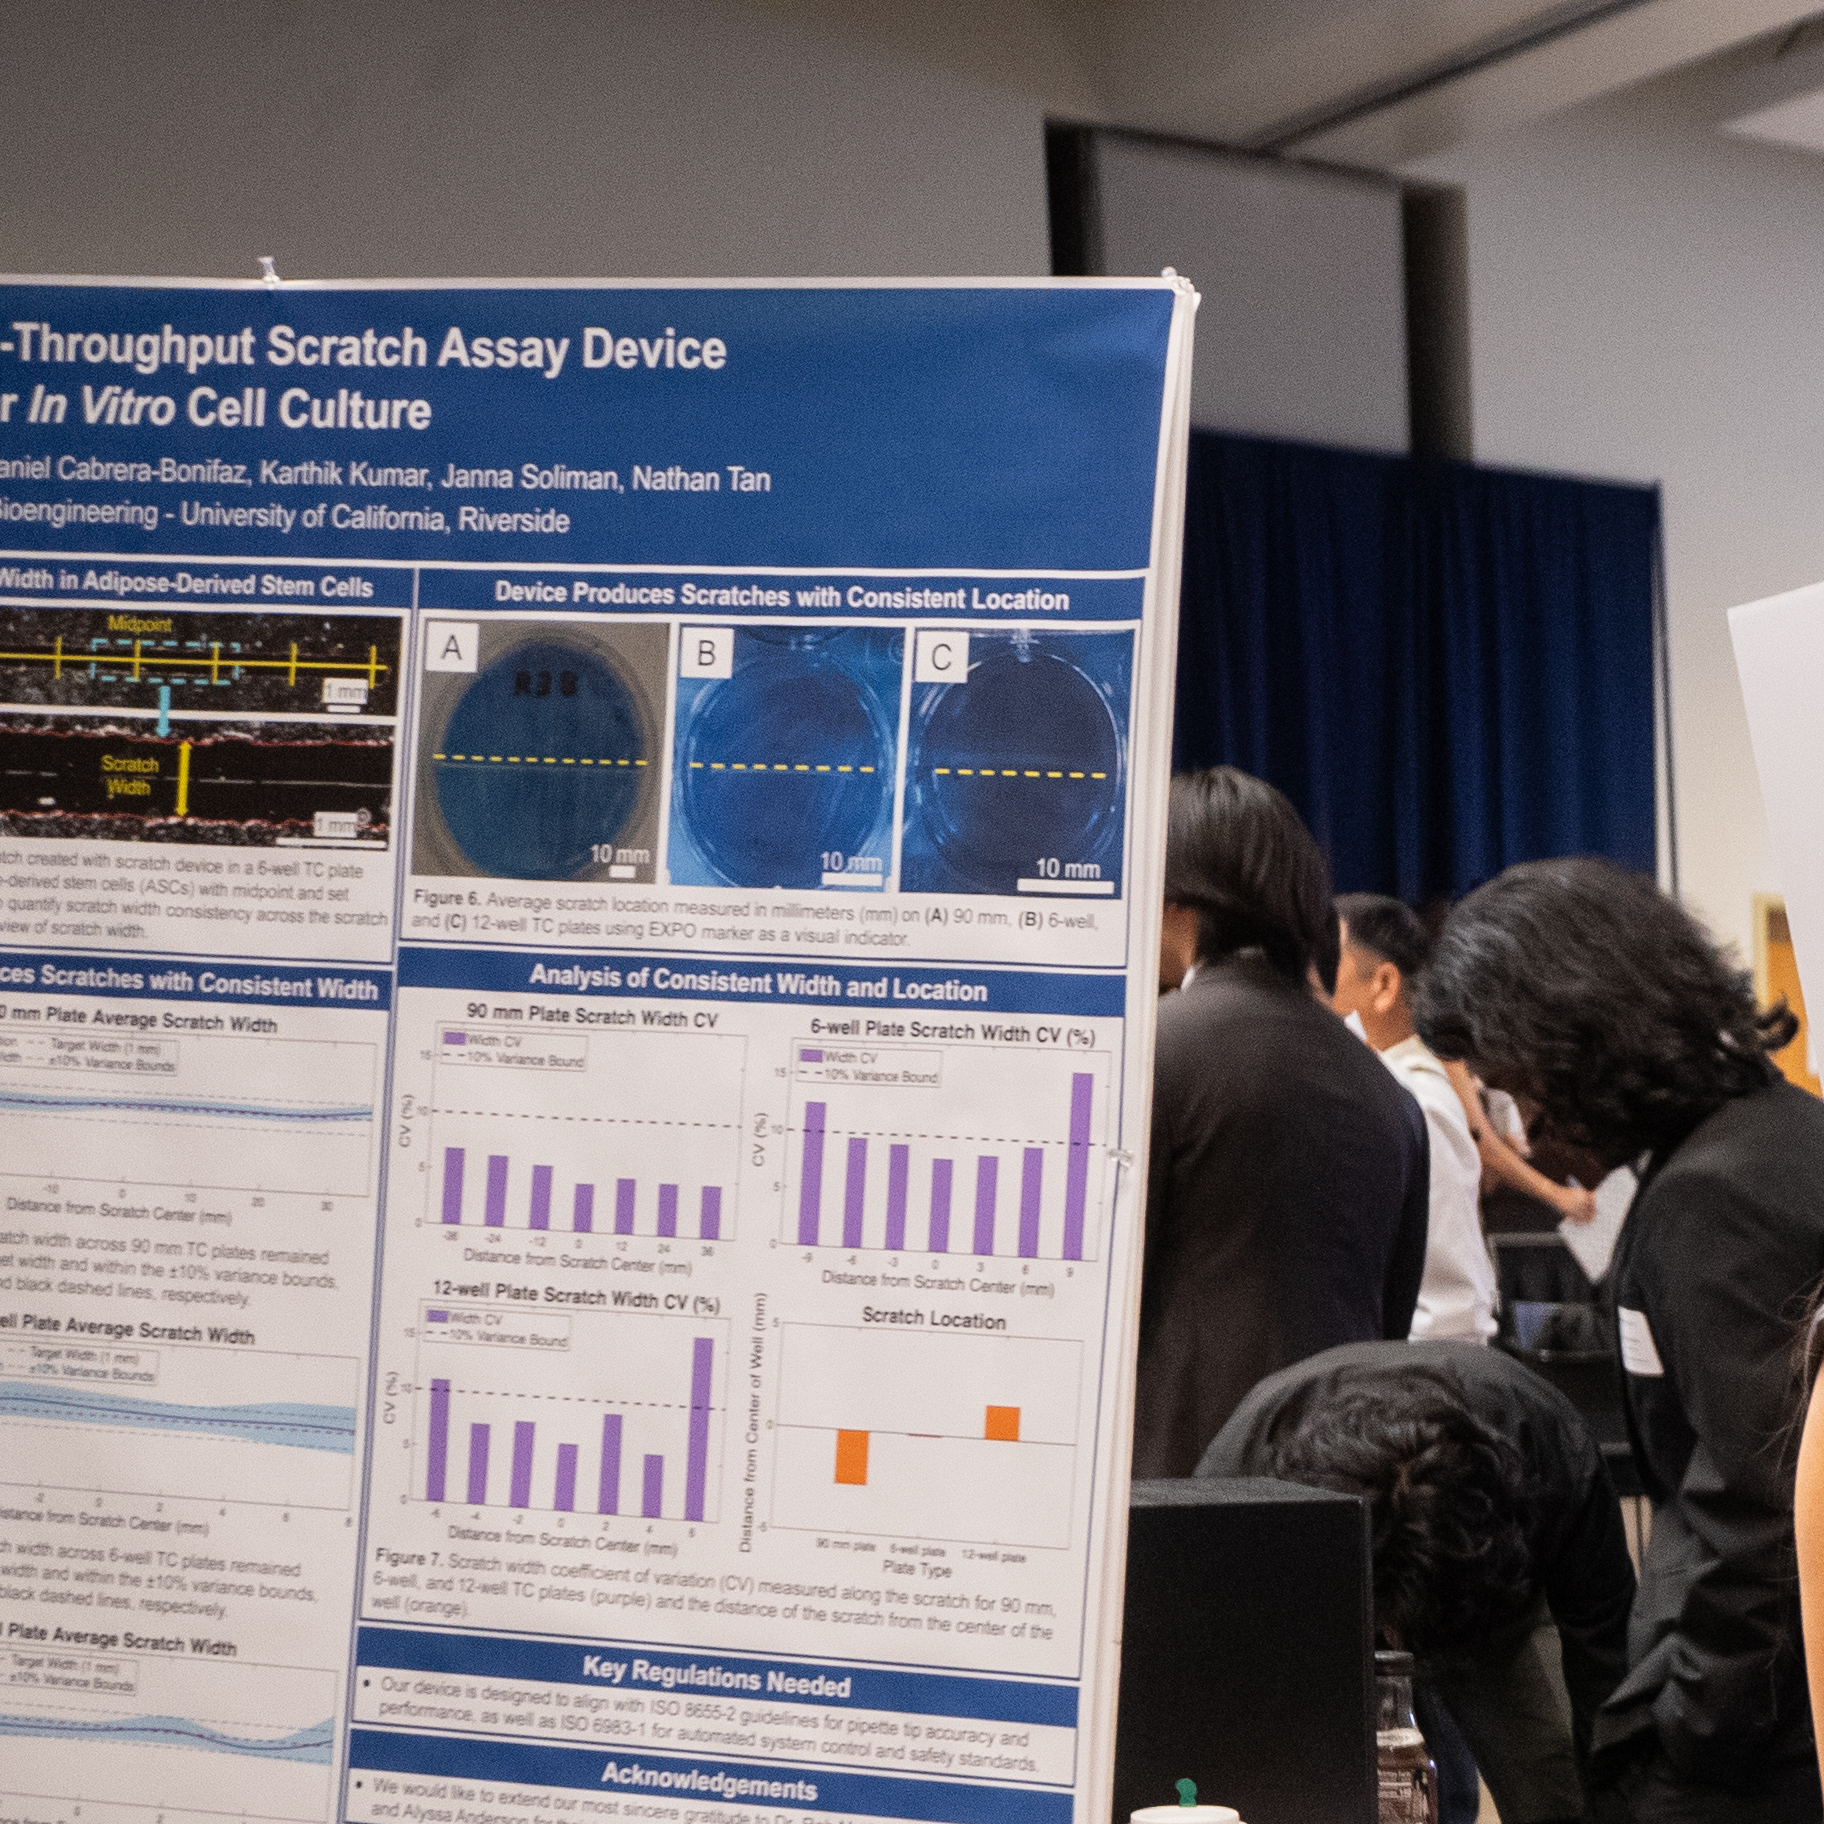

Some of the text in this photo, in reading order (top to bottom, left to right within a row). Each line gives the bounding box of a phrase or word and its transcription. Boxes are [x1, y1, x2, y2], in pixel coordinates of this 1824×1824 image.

[267, 325, 427, 367] Scratch
[436, 326, 570, 380] Assay
[582, 326, 727, 370] Device
[27, 384, 68, 424] In
[81, 385, 176, 426] Vitro
[187, 386, 266, 427] Cell
[278, 387, 432, 430] Culture
[56, 456, 252, 486] Cabrera-Bonifaz,
[259, 458, 343, 484] Karthik
[349, 461, 433, 490] Kumar,
[441, 463, 513, 489] Janna
[520, 463, 624, 494] Soliman,
[632, 465, 720, 491] Nathan
[727, 466, 771, 492] Tan
[0, 496, 158, 530] ioengineering
[180, 501, 296, 534] University
[302, 503, 327, 527] of
[331, 503, 451, 534] California,
[458, 505, 570, 534] Riverside
[0, 568, 374, 598] Width in Adipose-Derived Stem Cells
[495, 580, 1070, 611] Device Produces Scratches with Consistent Location
[108, 615, 172, 633] Midpoint
[441, 634, 462, 661] A
[698, 640, 716, 666] B
[931, 644, 952, 670] C
[101, 755, 159, 772] Scratch
[107, 779, 151, 796] Width
[590, 844, 650, 862] 10 mm
[821, 852, 883, 871] 10 mm
[1037, 859, 1101, 878] 10 mm
[413, 889, 462, 908] Figure
[488, 892, 552, 912] Average
[556, 896, 608, 912] scratch
[612, 896, 668, 914] location
[674, 900, 749, 918] measured
[755, 902, 766, 917] in
[771, 903, 854, 922] millimeters
[859, 907, 898, 925] (mm)
[902, 911, 920, 924] on
[925, 907, 948, 926] (A)
[954, 909, 973, 924] 90
[1019, 911, 1043, 929] (B)
[412, 915, 441, 929] and
[445, 912, 467, 932] (C)
[473, 915, 527, 932] 12-well
[532, 917, 554, 933] TC
[558, 919, 601, 937] plates
[606, 922, 643, 940] using
[649, 922, 695, 938] EXPO
[702, 924, 753, 940] marker
[758, 928, 775, 941] as
[780, 930, 789, 942] a
[794, 927, 839, 944] visual
[40, 963, 144, 990] Scratches
[149, 970, 193, 992] with
[199, 971, 312, 997] Consistent
[317, 977, 379, 1001] Width
[529, 963, 988, 1002] Analysis of Consistent Width and Location
[12, 1005, 278, 1034] mm Plate Average Scratch Width
[467, 1002, 719, 1028] 90 mm Plate Scratch Width CV
[811, 1018, 1095, 1048] 6-well Plate Scratch Width CV (%)
[433, 1280, 720, 1315] 12-well Plate Scratch Width CV (%)
[22, 1314, 255, 1345] Plate Average Scratch Width
[862, 1306, 1006, 1330] Scratch Location
[883, 1559, 952, 1579] Plate Type
[8, 1622, 237, 1656] Plate Average Scratch Width
[582, 1655, 851, 1698] Key Regulations Needed
[381, 1676, 409, 1693] Our
[413, 1678, 461, 1698] device
[465, 1683, 477, 1699] is
[482, 1684, 550, 1707] designed
[556, 1691, 569, 1708] to
[574, 1692, 610, 1713] align
[614, 1696, 644, 1713] with
[650, 1699, 678, 1717] ISO
[740, 1709, 818, 1730] guidelines
[824, 1713, 842, 1730] for
[847, 1717, 898, 1739] pipette
[904, 1721, 920, 1740] tip
[926, 1725, 994, 1747] accuracy
[1000, 1729, 1029, 1747] and
[602, 1761, 818, 1801] Acknowledgements
